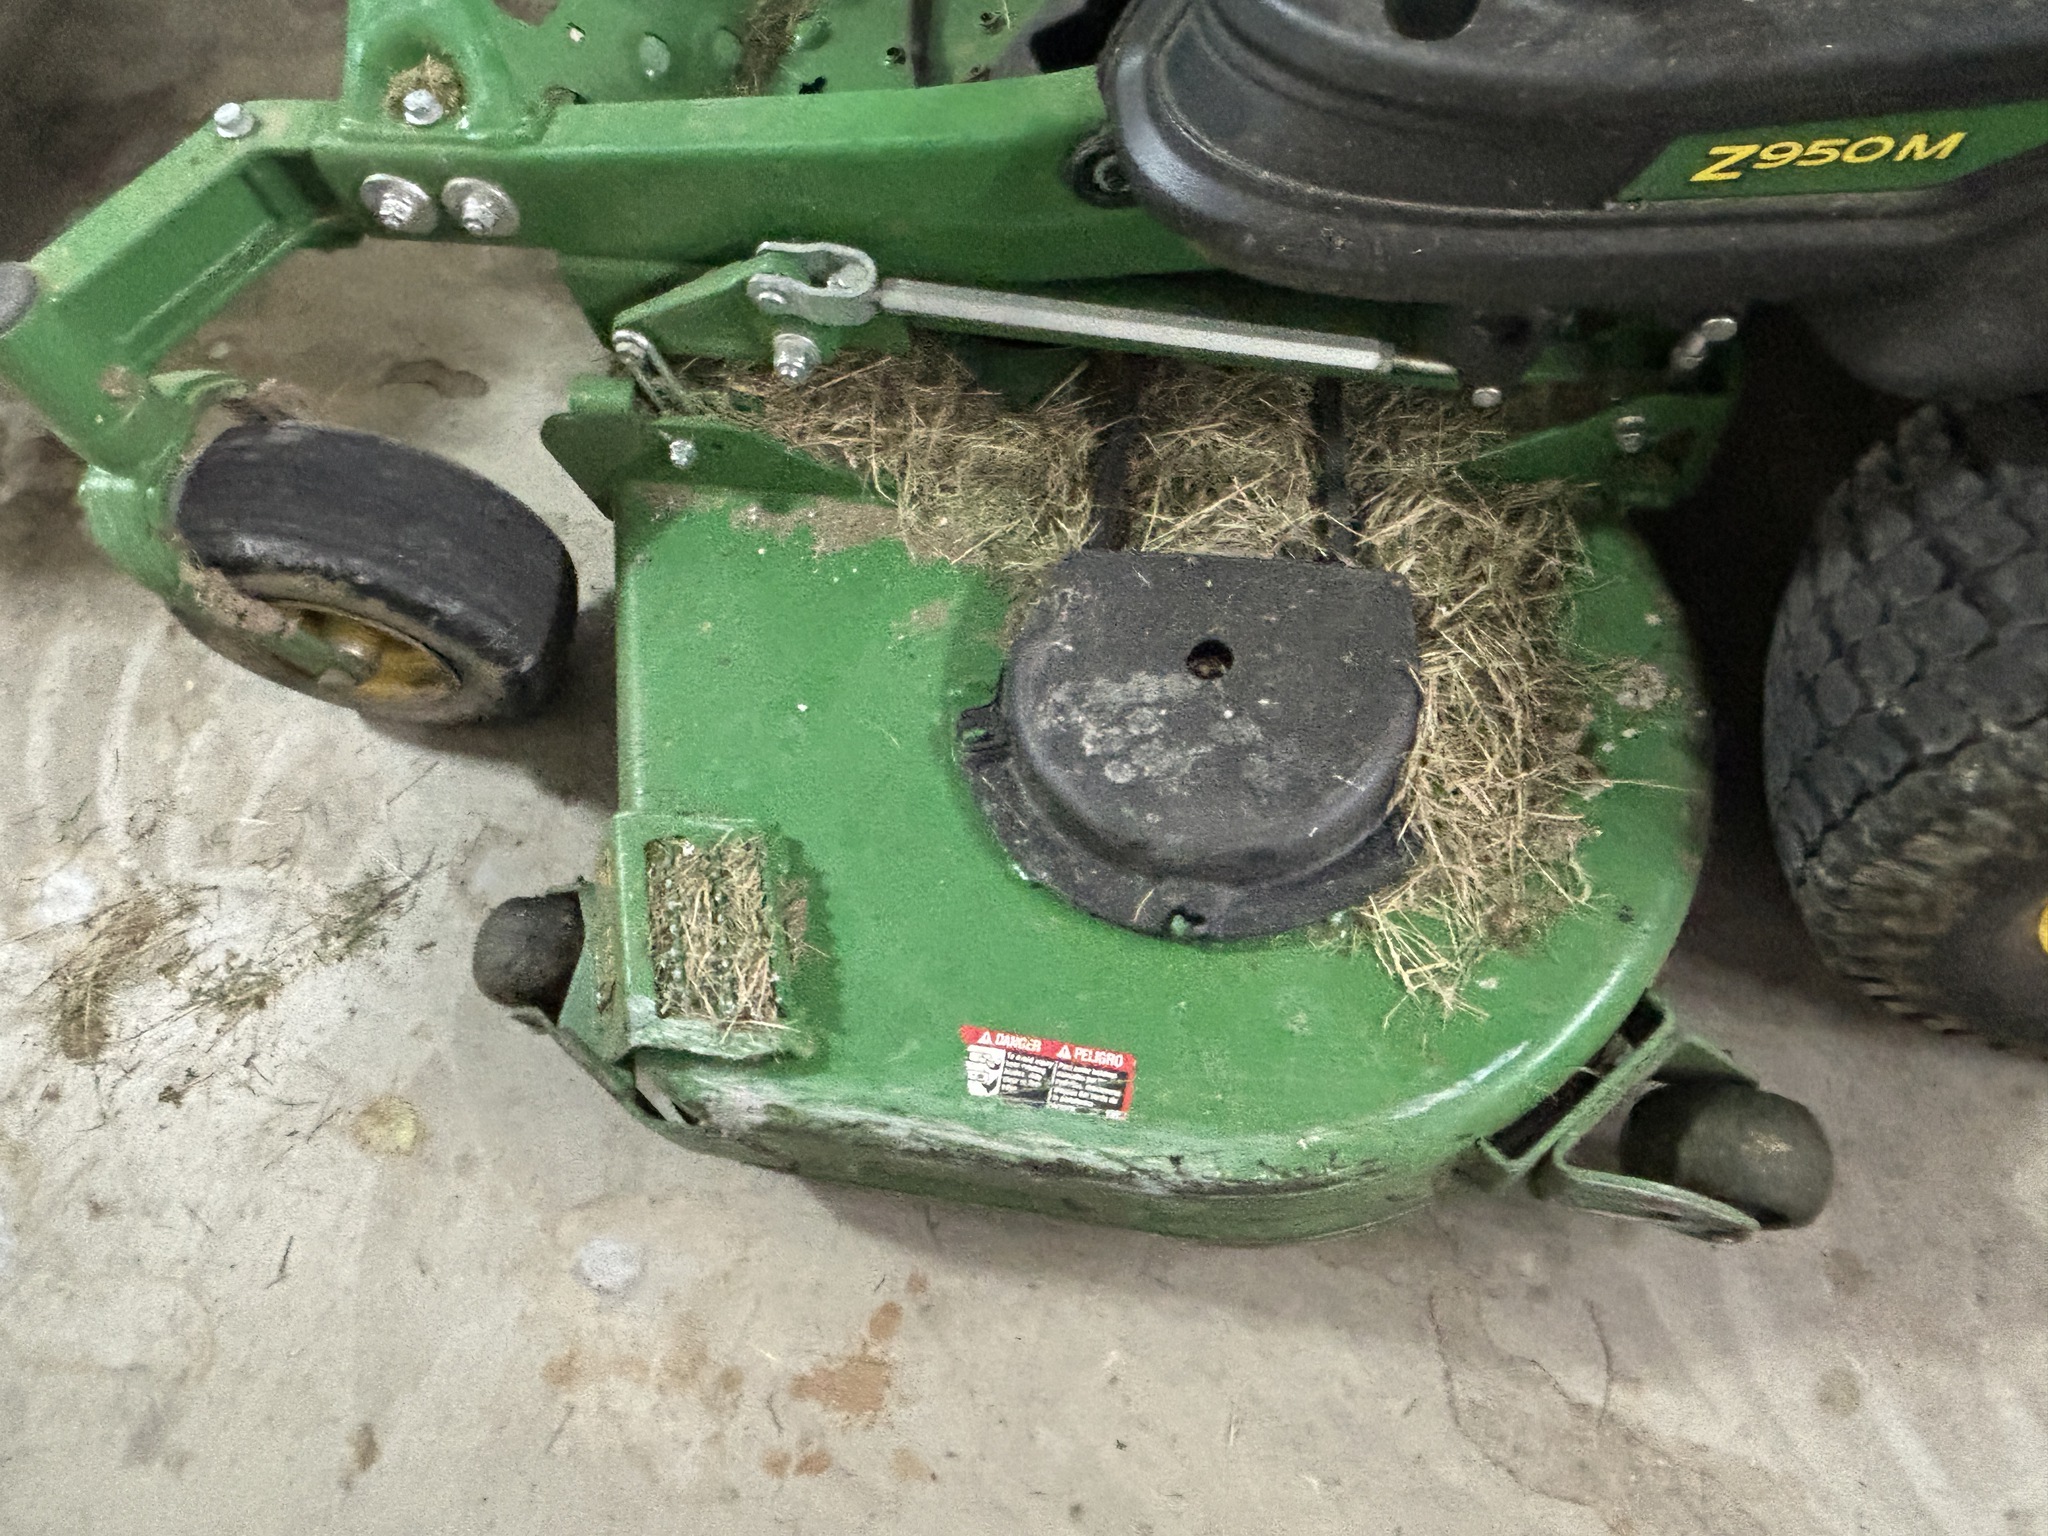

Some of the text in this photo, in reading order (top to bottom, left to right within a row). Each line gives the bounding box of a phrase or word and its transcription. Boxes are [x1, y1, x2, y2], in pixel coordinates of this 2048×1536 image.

[1690, 131, 1968, 182] Z950M
[995, 1033, 1042, 1051] DANGER
[1074, 1047, 1124, 1068] PELIGRO
